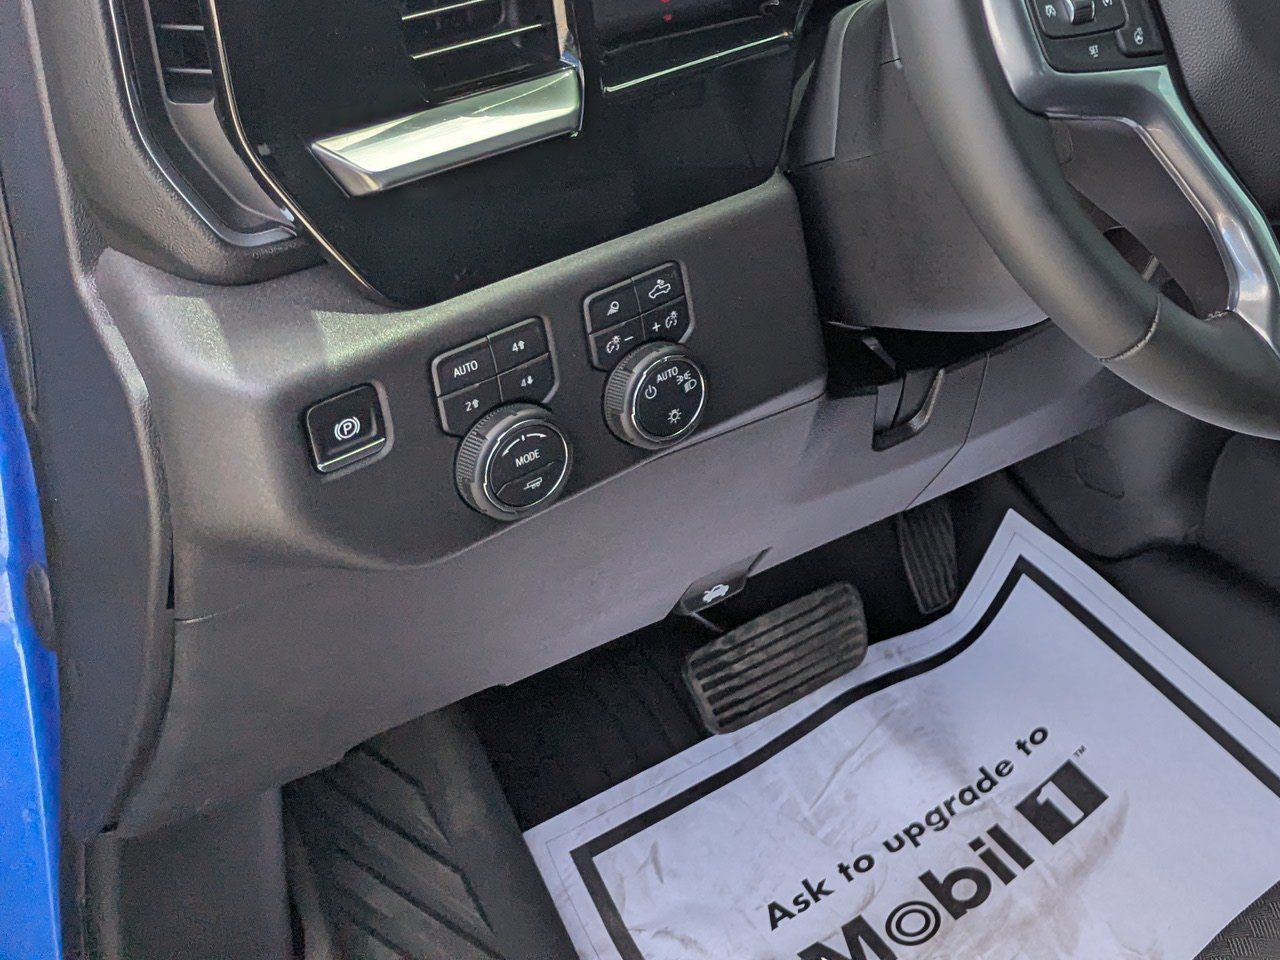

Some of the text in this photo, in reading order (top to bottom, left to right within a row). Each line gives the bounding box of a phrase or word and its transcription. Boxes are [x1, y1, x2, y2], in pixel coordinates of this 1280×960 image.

[1088, 44, 1099, 55] SET
[453, 359, 479, 378] AUTO
[656, 366, 679, 383] AUTO
[515, 448, 540, 467] MODE
[766, 726, 1049, 931] Ask to upgrade to
